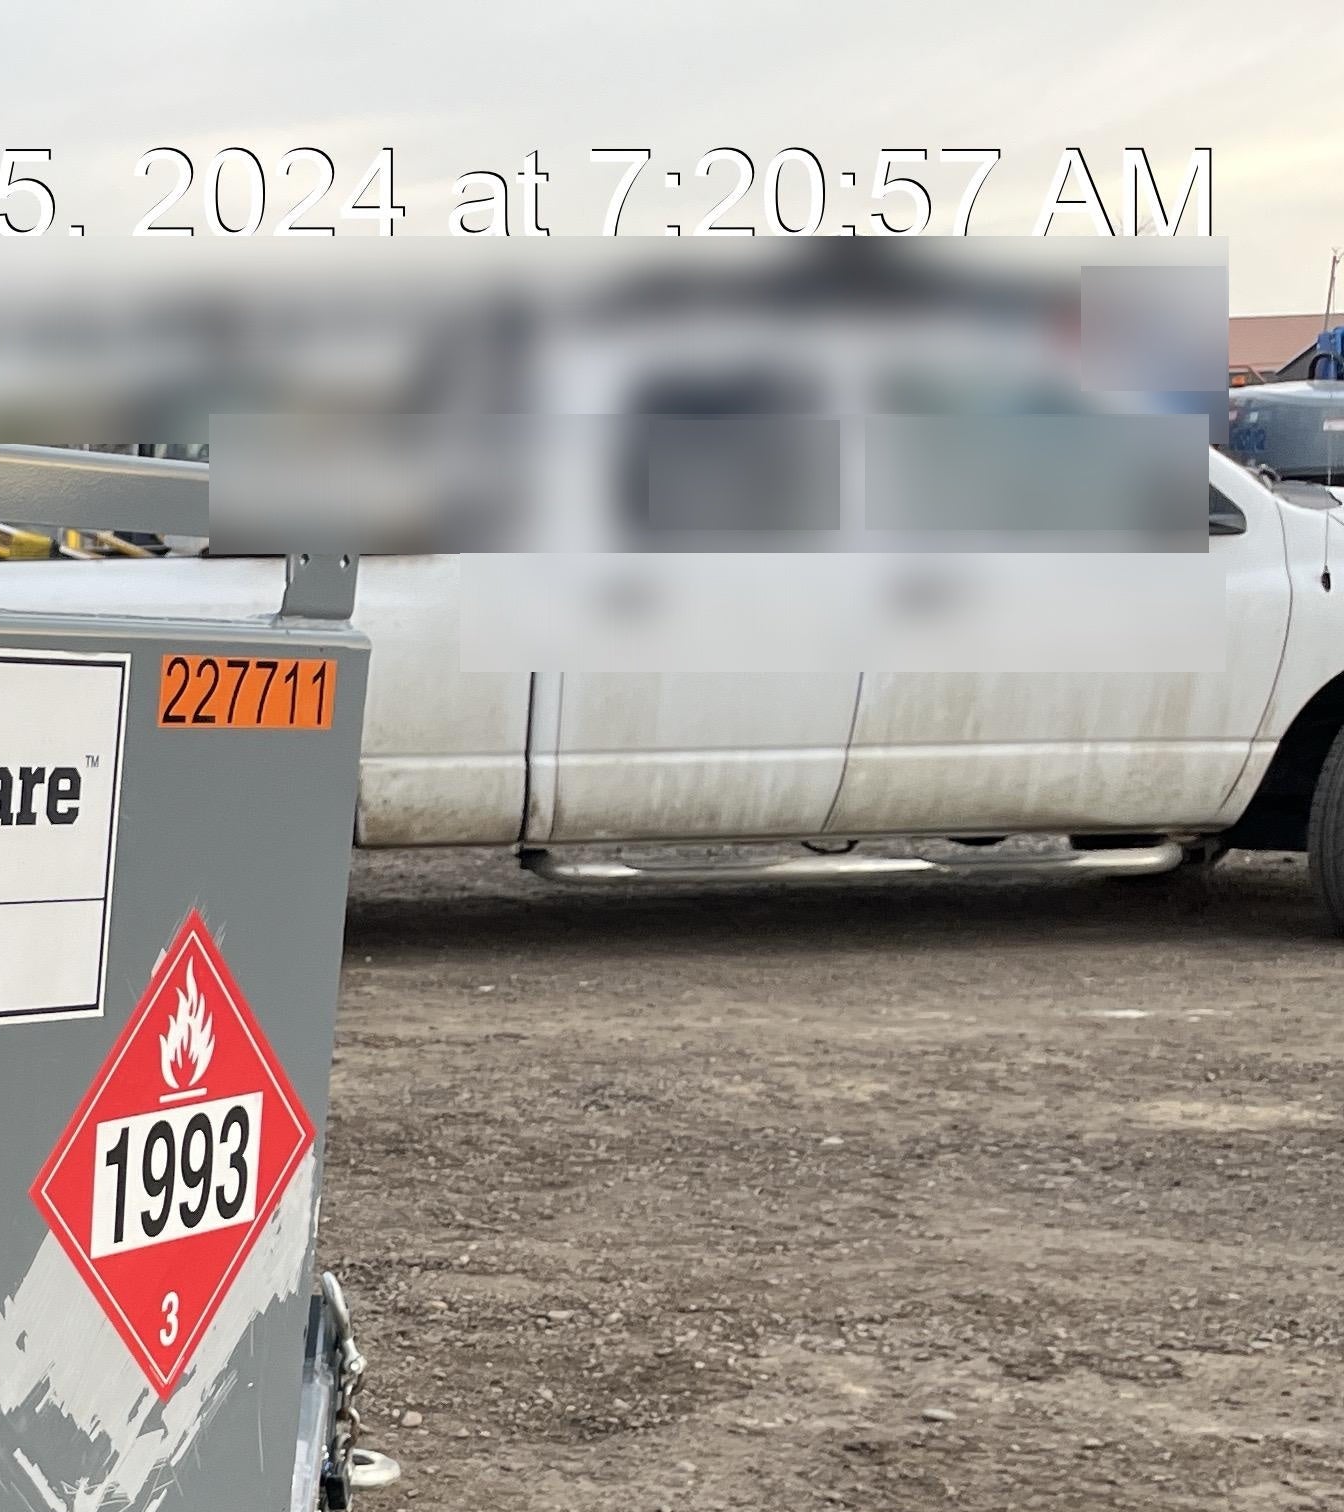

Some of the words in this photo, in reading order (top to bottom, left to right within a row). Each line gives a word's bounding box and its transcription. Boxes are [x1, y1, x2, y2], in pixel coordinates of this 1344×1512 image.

[161, 656, 327, 726] 227711
[105, 1104, 250, 1244] 1993
[158, 1290, 180, 1348] 3
